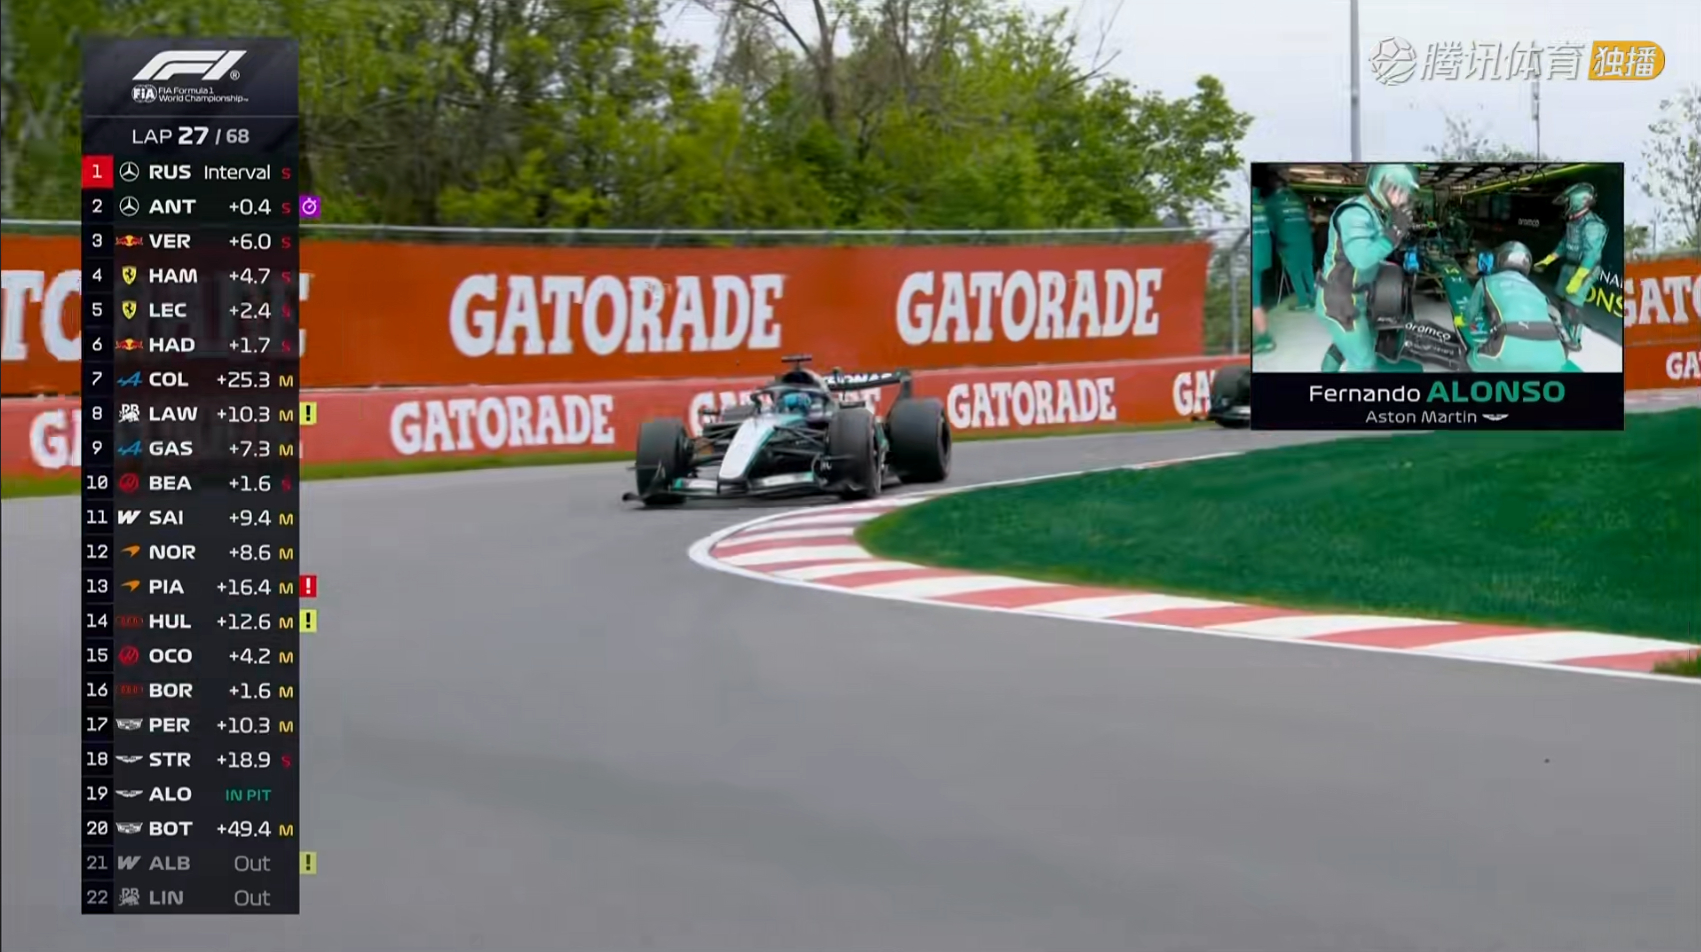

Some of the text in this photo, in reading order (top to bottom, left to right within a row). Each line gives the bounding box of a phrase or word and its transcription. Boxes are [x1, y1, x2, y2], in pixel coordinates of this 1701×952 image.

[449, 273, 785, 357] GATORADE
[896, 268, 1163, 345] GATORADE
[1405, 322, 1451, 340] aramco
[1666, 350, 1701, 380] GA
[948, 377, 1117, 429] GATORADE
[1173, 369, 1215, 416] GA
[390, 394, 615, 455] GATORADE
